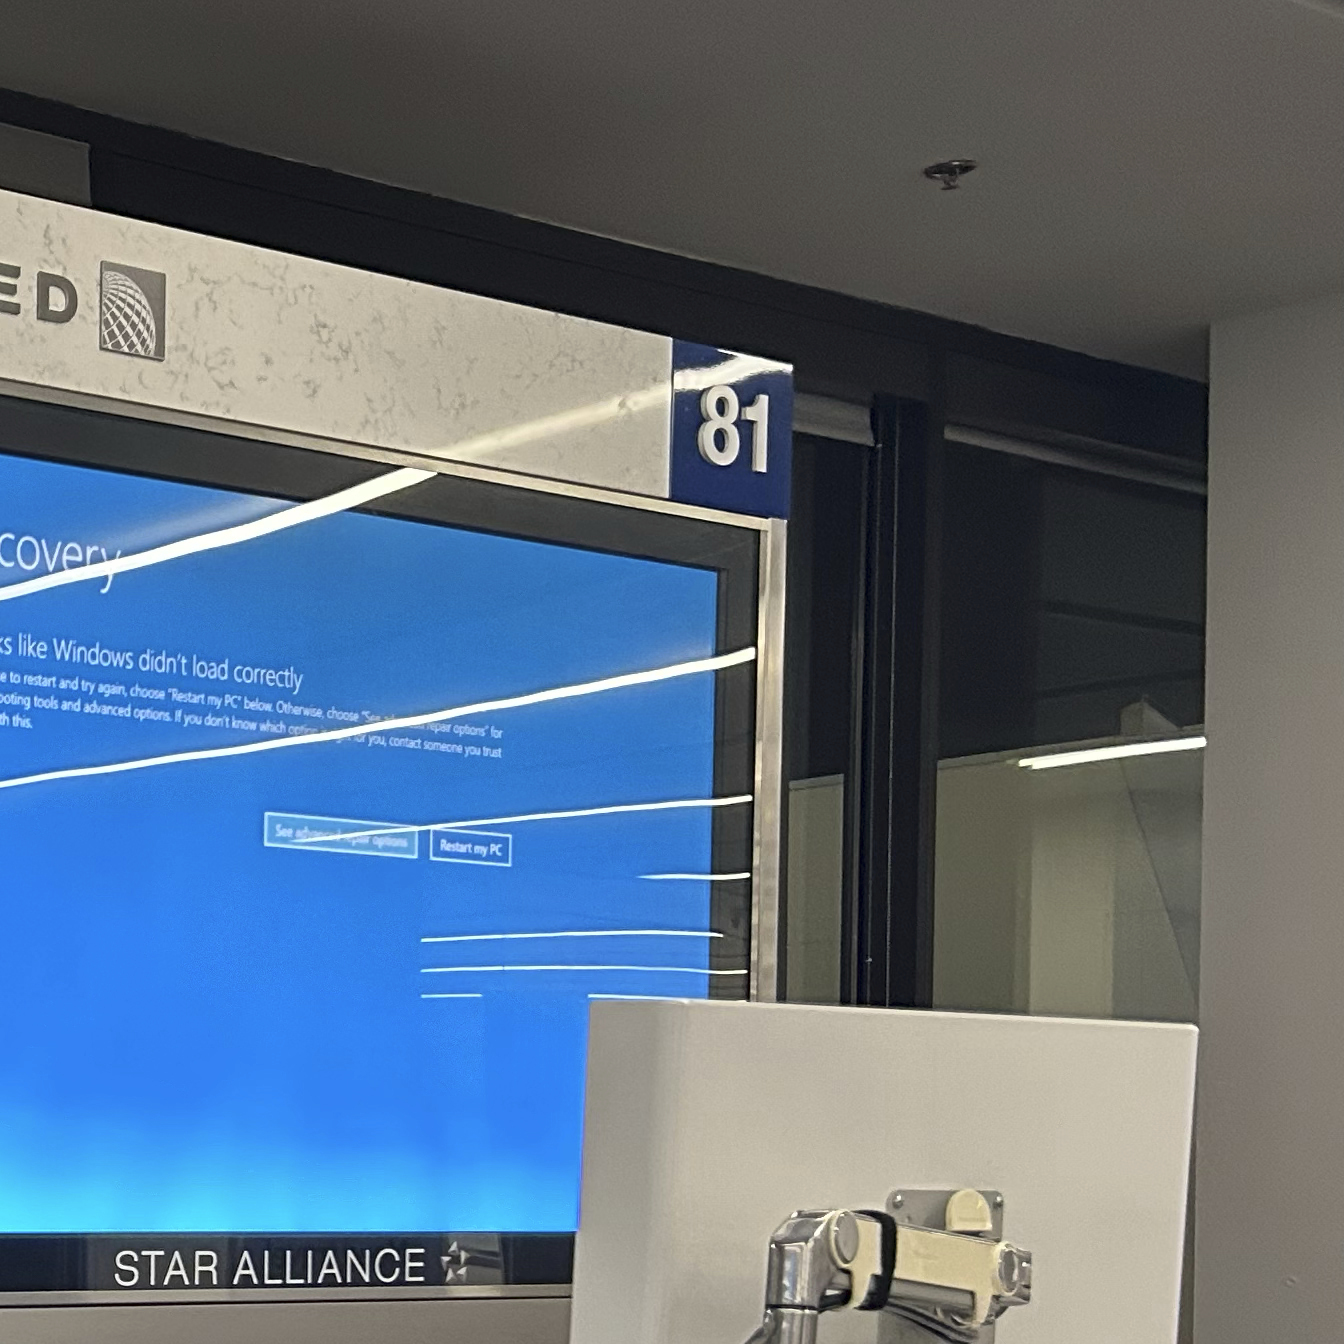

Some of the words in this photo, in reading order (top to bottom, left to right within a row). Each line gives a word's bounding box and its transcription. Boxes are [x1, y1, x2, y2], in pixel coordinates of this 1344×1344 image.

[697, 385, 769, 473] 81
[18, 632, 48, 659] like
[53, 637, 134, 670] Windows
[138, 648, 187, 676] didn't
[192, 654, 229, 681] load
[233, 665, 303, 695] correctly
[10, 671, 21, 684] to
[23, 673, 56, 688] restart
[58, 676, 79, 691] and
[81, 680, 96, 695] try
[130, 683, 165, 701] choose
[207, 695, 222, 710] my
[327, 708, 359, 723] choose
[490, 726, 503, 739] for
[12, 713, 33, 729] this.
[33, 695, 59, 710] tools
[61, 698, 81, 712] and
[83, 699, 131, 718] advanced
[174, 709, 183, 723] If
[183, 712, 203, 727] you
[204, 713, 230, 728] don't
[231, 716, 257, 732] know
[259, 719, 287, 734] which
[389, 736, 422, 750] contact
[423, 740, 463, 754] someone
[464, 744, 481, 758] you
[483, 746, 503, 760] trust
[275, 823, 293, 839] See
[372, 834, 409, 850] options
[439, 838, 472, 855] Restart
[473, 843, 488, 858] my
[489, 842, 503, 857] PC
[114, 1249, 218, 1287] STAR
[232, 1248, 426, 1286] ALLIANCE
